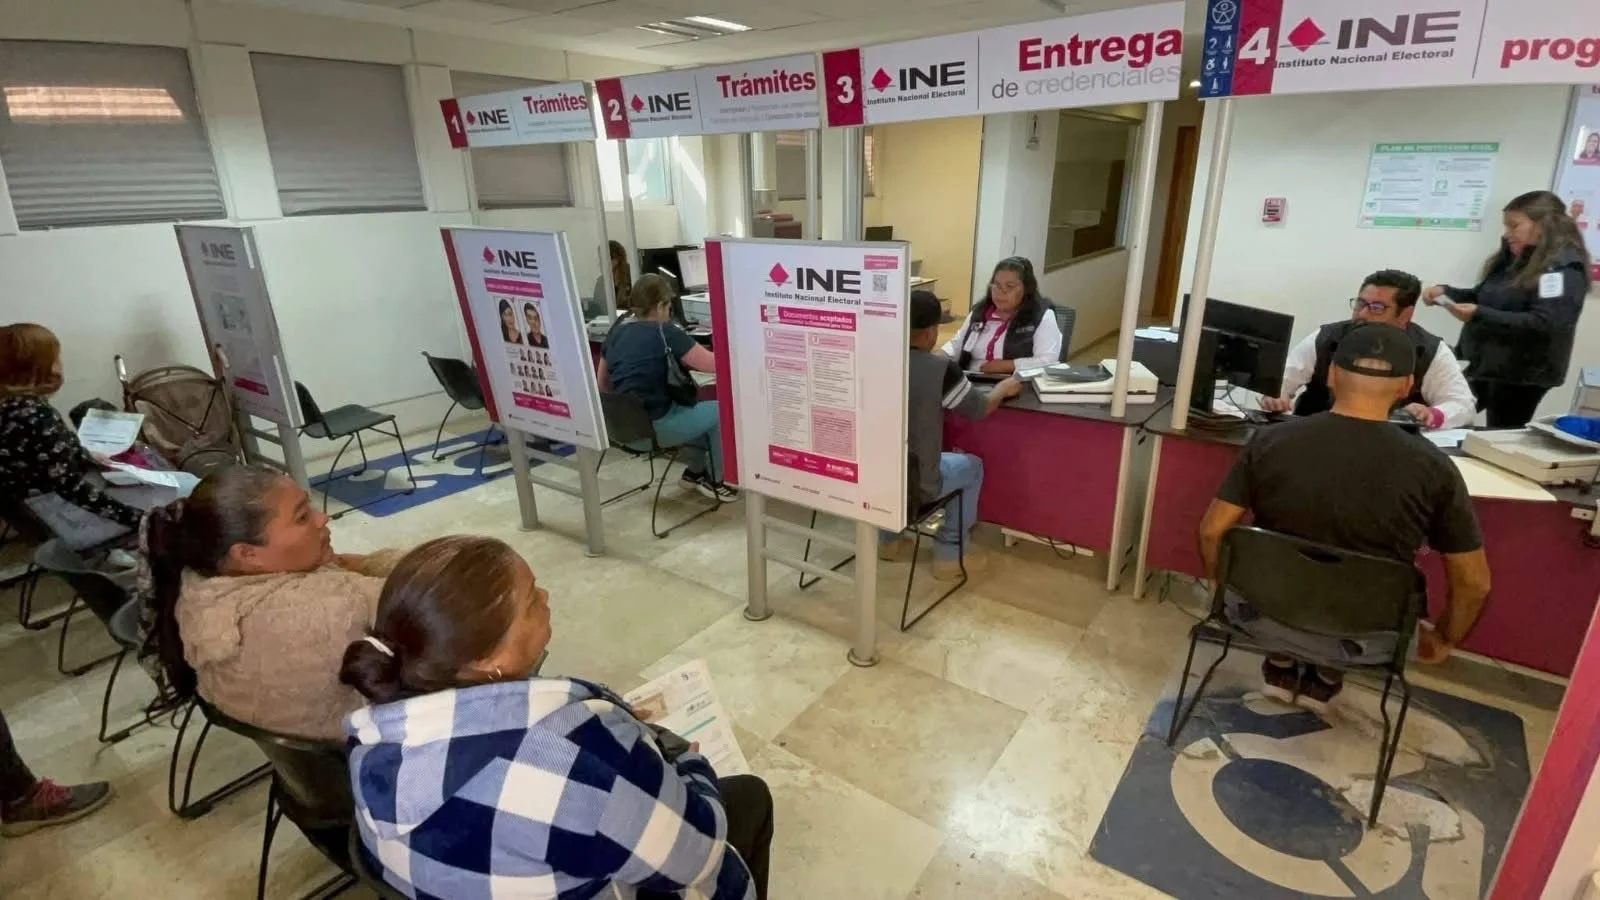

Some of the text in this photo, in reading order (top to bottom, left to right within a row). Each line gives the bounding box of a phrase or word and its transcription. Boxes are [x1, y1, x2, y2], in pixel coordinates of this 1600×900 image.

[1336, 11, 1461, 50] INE
[1019, 29, 1182, 72] Entrega
[1238, 27, 1271, 64] 4
[1330, 53, 1388, 64] Nacional
[1392, 49, 1455, 61] Electoral
[1500, 38, 1600, 69] prog
[716, 69, 816, 98] Trámites
[899, 61, 966, 91] INE
[992, 65, 1180, 99] de credenciales
[837, 75, 855, 104] 3
[866, 88, 966, 106] Instituto Nacional Electoral
[523, 93, 588, 115] Trámites
[607, 99, 622, 121] 2
[648, 92, 691, 113] INE
[451, 115, 461, 133] 1
[478, 109, 509, 125] INE
[210, 244, 235, 260] INE
[498, 250, 538, 269] INE
[796, 267, 861, 294] INE
[764, 291, 861, 305] Instituto Nacional Electoral
